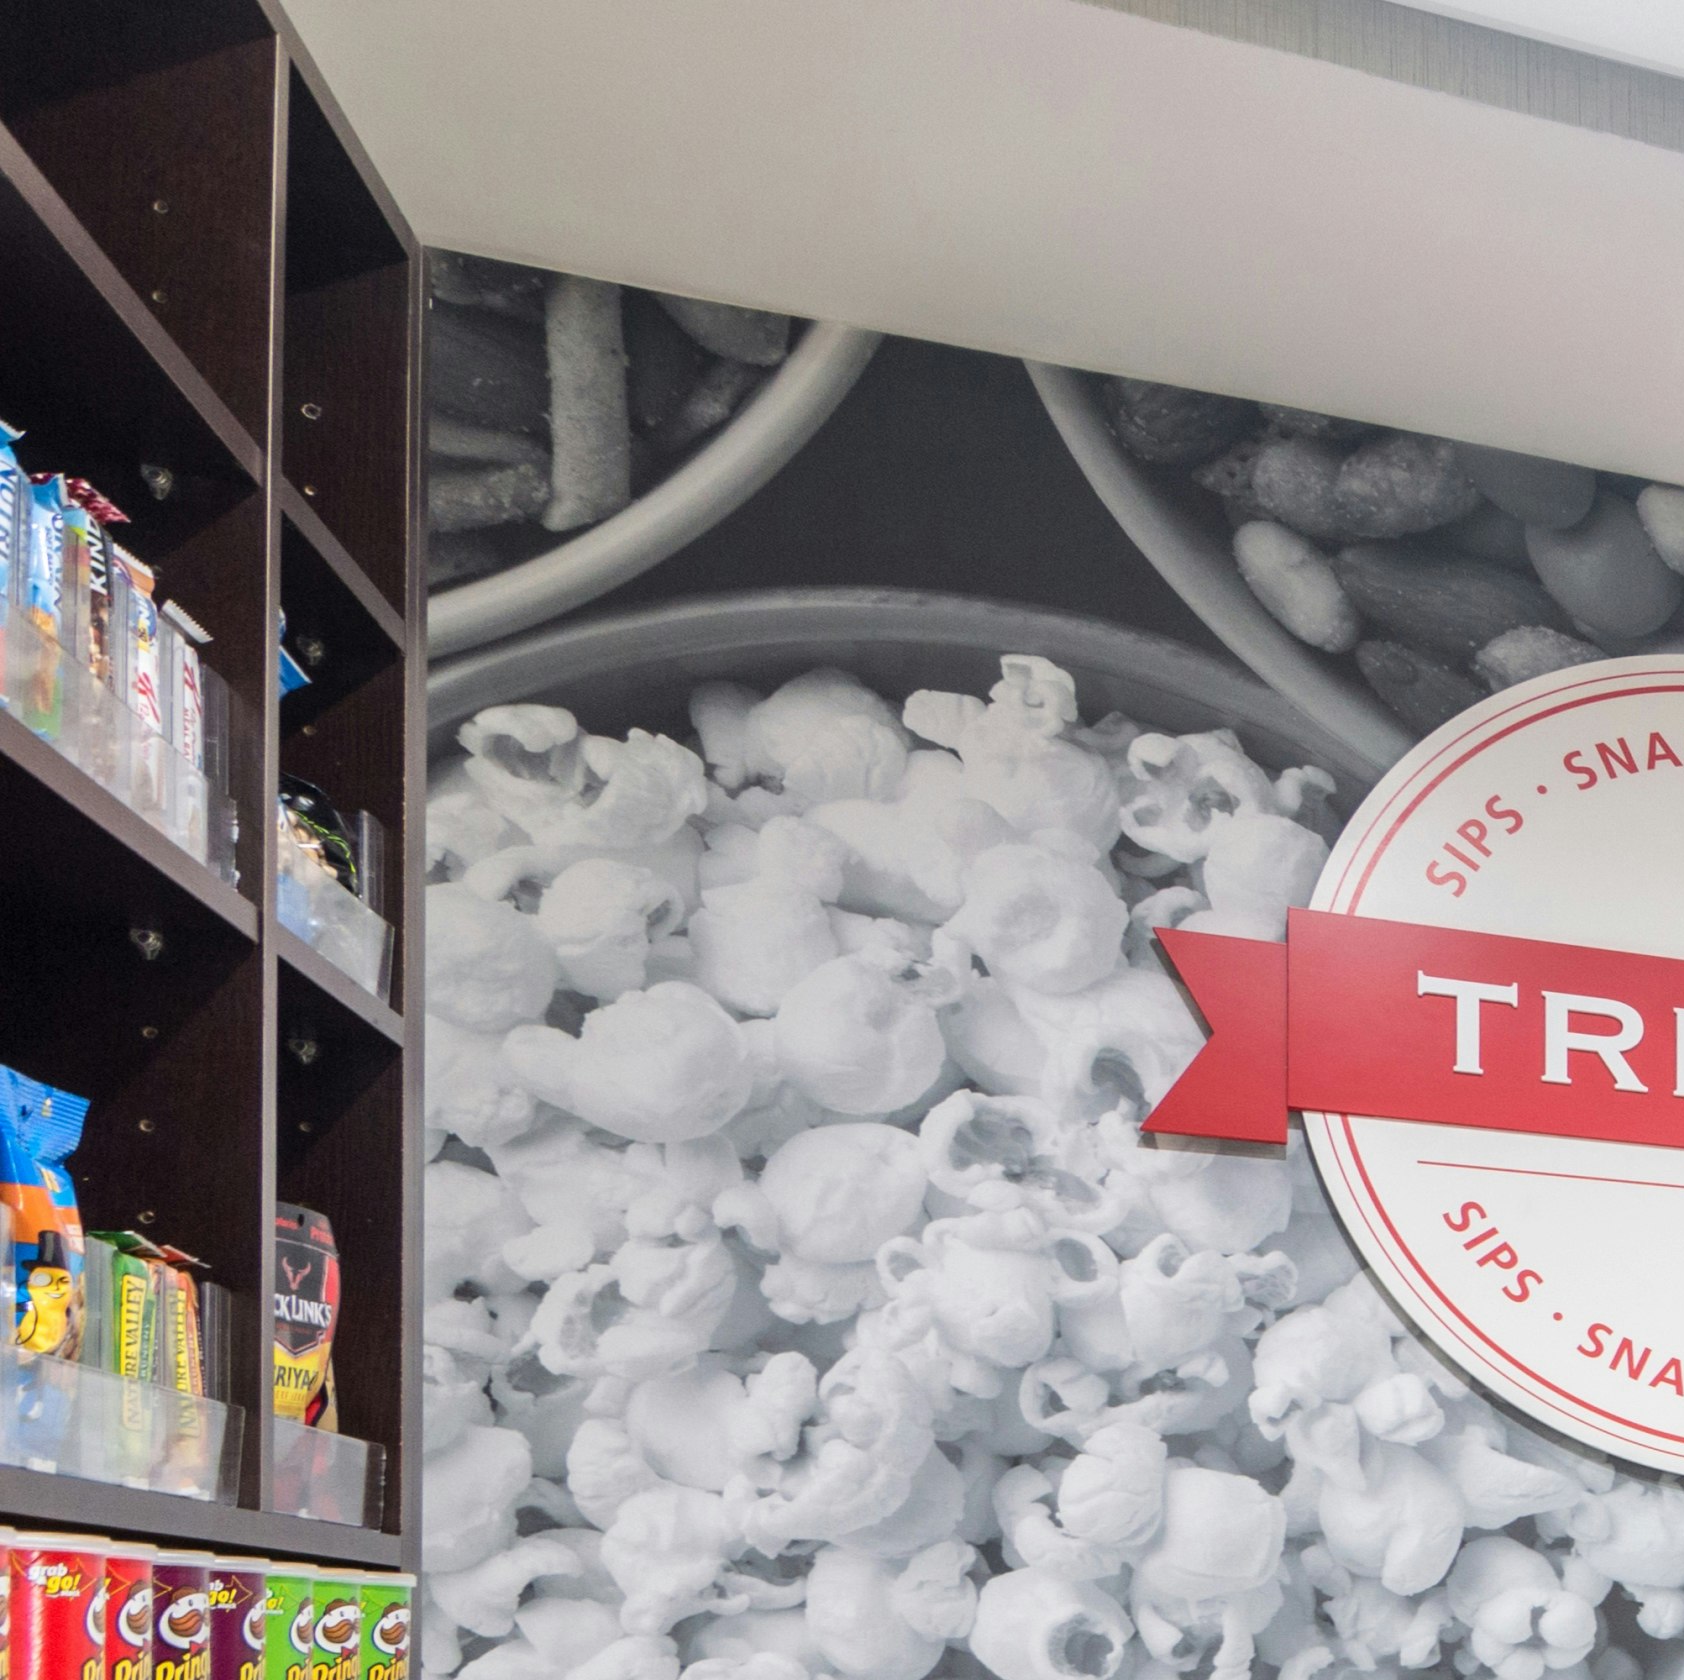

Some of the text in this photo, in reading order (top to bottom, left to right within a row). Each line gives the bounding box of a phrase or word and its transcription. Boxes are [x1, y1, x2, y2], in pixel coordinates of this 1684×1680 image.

[1424, 793, 1525, 896] SIPS
[1443, 1200, 1544, 1303] SIPS
[126, 1280, 144, 1343] VALLEY
[27, 1563, 67, 1581] grab
[45, 1573, 81, 1594] go!
